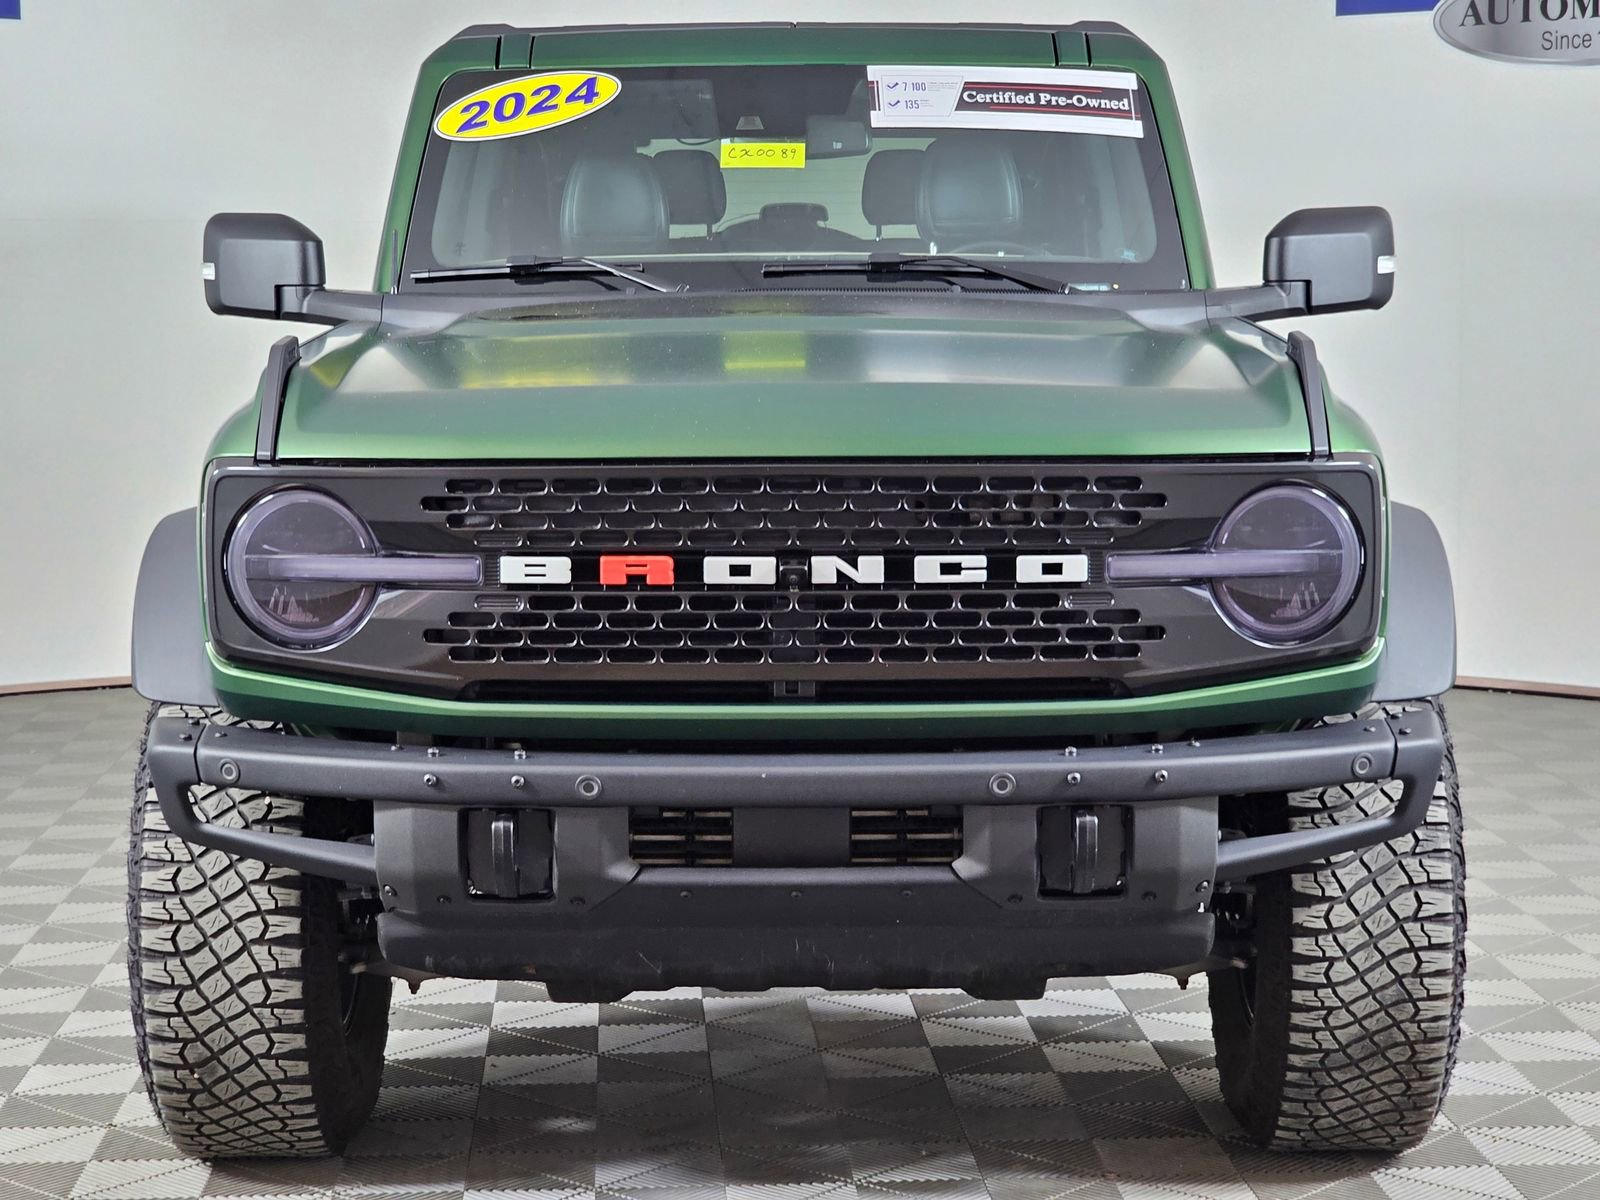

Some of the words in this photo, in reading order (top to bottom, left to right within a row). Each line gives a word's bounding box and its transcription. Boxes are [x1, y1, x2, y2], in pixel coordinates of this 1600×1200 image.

[1541, 30, 1592, 51] Since
[456, 76, 599, 134] 2024
[905, 100, 920, 110] 135
[962, 90, 1036, 105] Certified
[1039, 92, 1130, 111] Pre-Owned
[499, 554, 1088, 585] BRONCO
